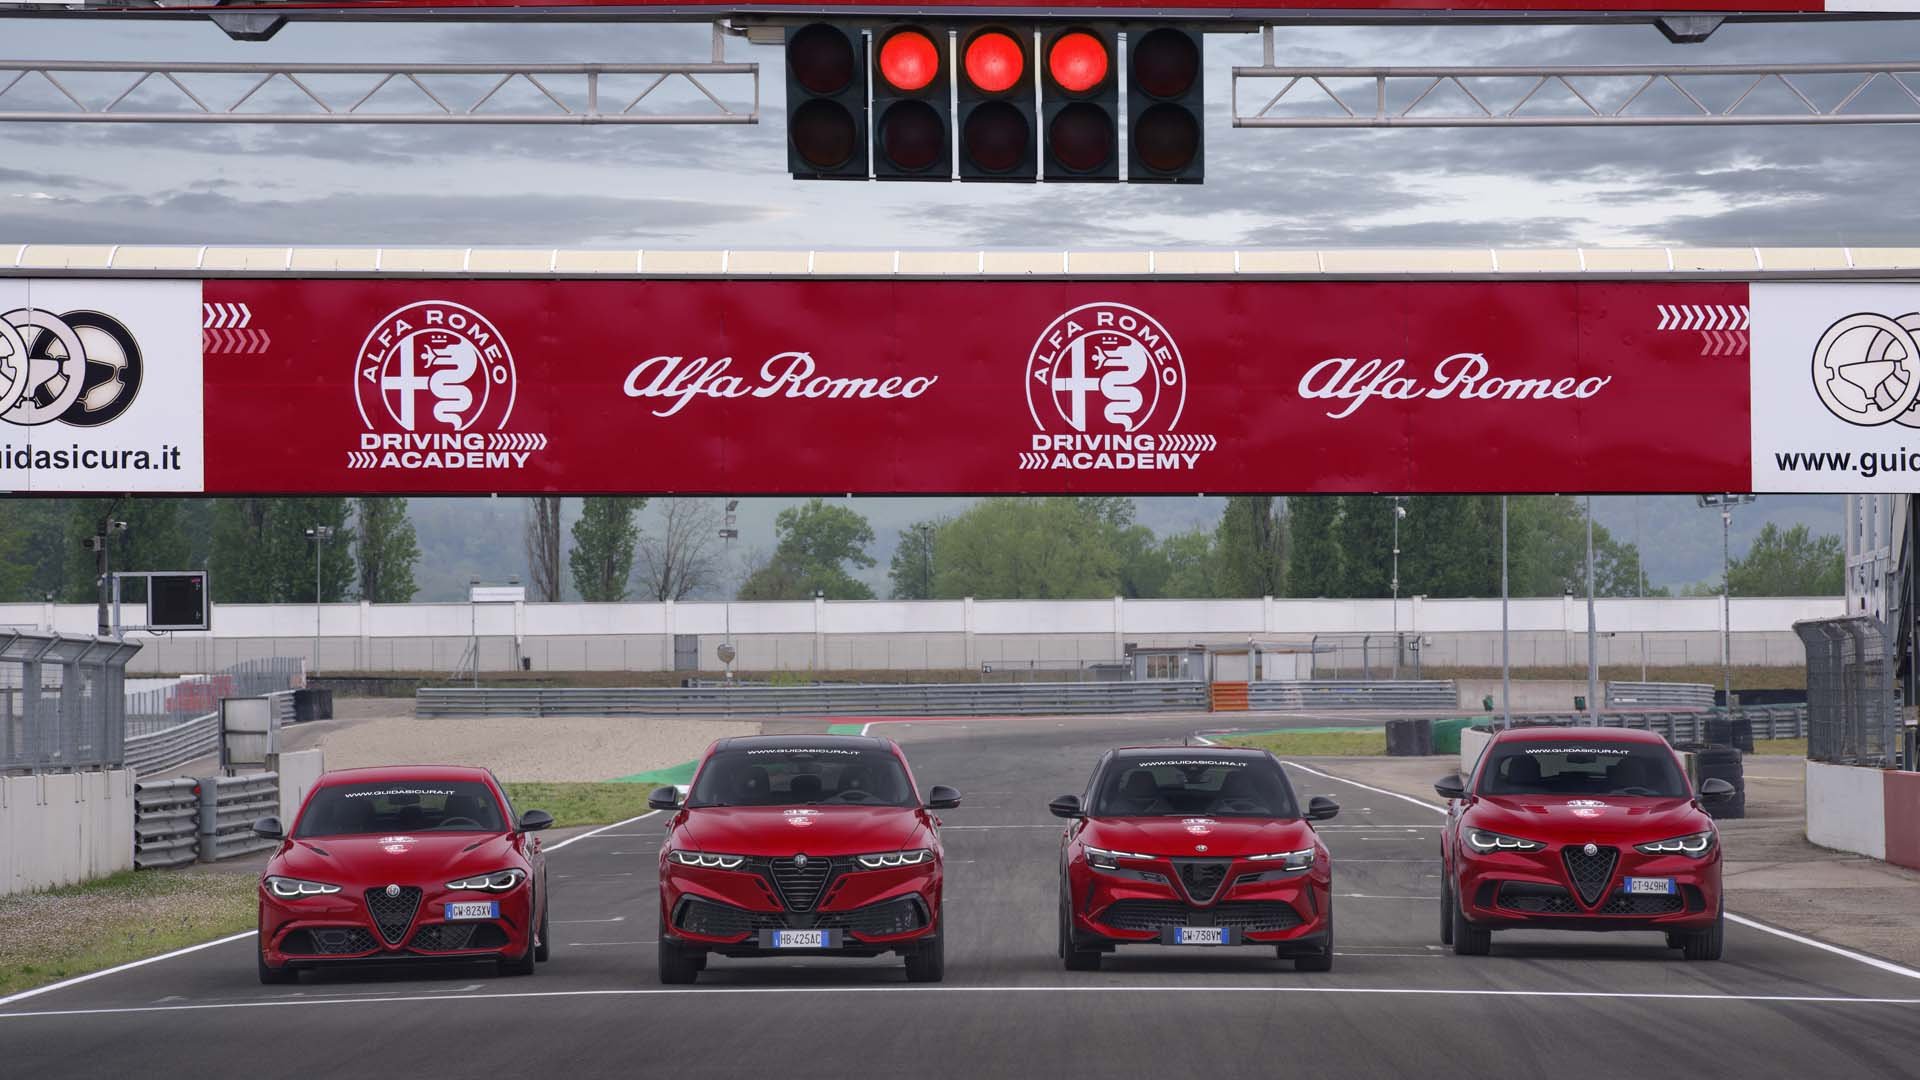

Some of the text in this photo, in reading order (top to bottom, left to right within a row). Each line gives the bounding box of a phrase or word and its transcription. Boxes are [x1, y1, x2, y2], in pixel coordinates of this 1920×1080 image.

[363, 310, 508, 385] ALFA ROMEO
[1034, 311, 1178, 386] ALFA ROMEO
[623, 352, 939, 418] Alfa Romeo
[1298, 353, 1612, 419] Alfa Romeo
[360, 433, 485, 450] DRIVING
[1032, 434, 1155, 451] DRIVING
[0, 444, 181, 471] idasicura.it
[380, 452, 531, 469] ACADEMY
[1050, 453, 1201, 470] ACADEMY
[1138, 759, 1248, 768] WWW.GUIDASICURA.IT
[345, 789, 456, 798] WWW.GUIDASICURA.IT
